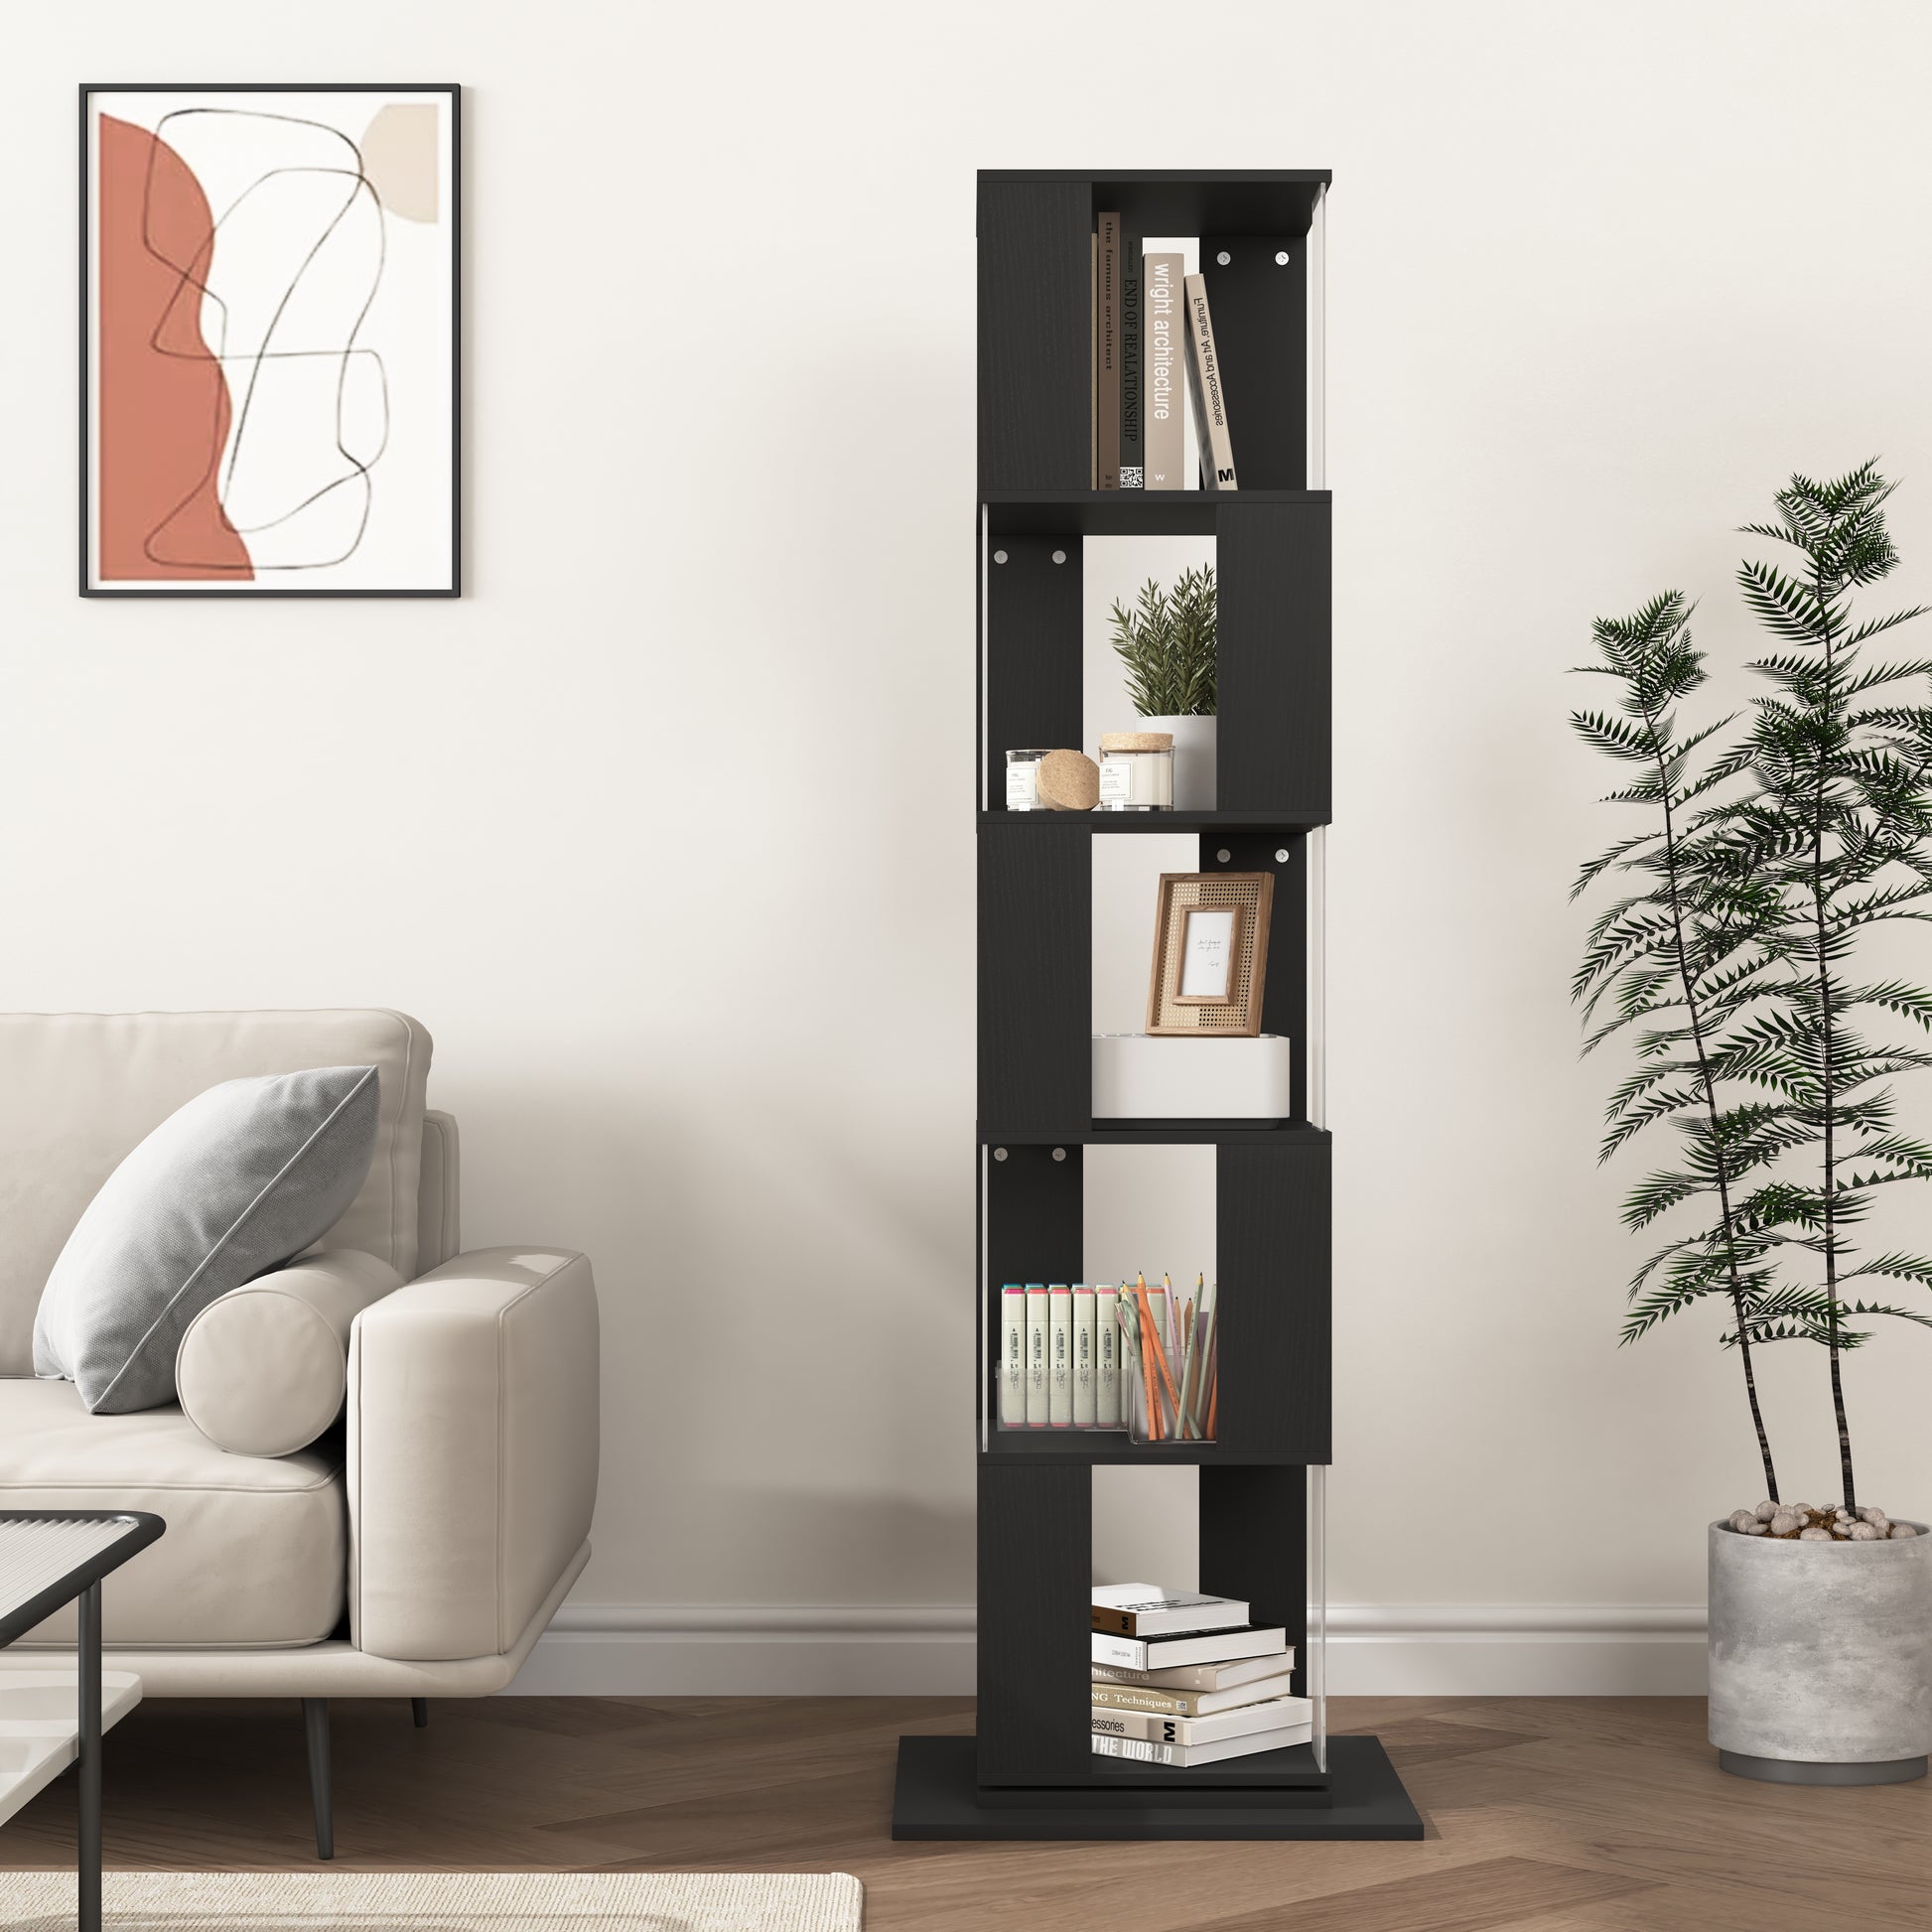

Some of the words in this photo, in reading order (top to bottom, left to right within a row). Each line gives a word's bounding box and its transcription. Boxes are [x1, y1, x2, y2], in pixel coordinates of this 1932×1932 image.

[1124, 278, 1137, 308] END
[1150, 263, 1173, 315] wright
[1124, 311, 1137, 330] OF
[1154, 320, 1173, 420] architecture
[1124, 333, 1137, 442] REALATIONSHIP
[1217, 468, 1235, 483] M
[1114, 1694, 1173, 1708] Techniques
[1164, 1722, 1175, 1742] M
[1122, 1739, 1173, 1763] WORLD
